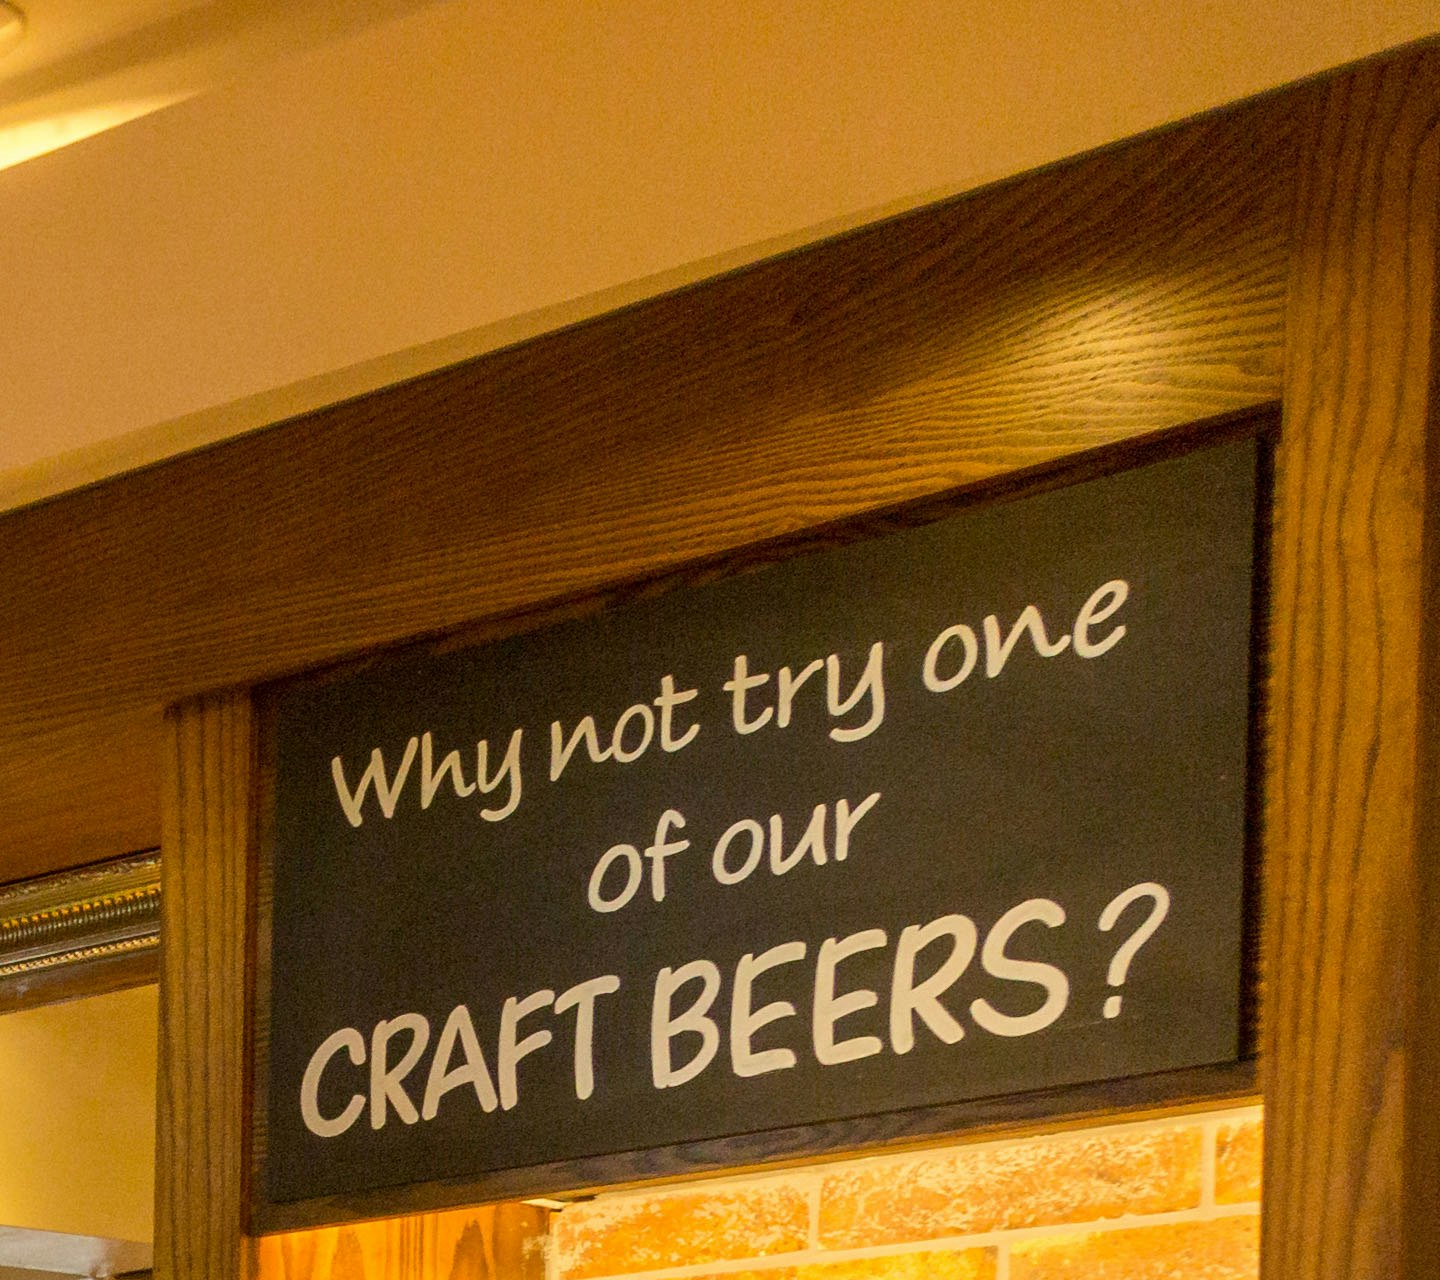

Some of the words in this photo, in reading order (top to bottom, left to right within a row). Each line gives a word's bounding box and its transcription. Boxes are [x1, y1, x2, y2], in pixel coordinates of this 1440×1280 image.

[331, 728, 523, 828] Why
[549, 674, 701, 782] not
[722, 641, 886, 743] try
[922, 579, 1130, 693] one
[587, 808, 691, 913] of
[711, 792, 882, 886] our
[300, 974, 621, 1138] CRAFT
